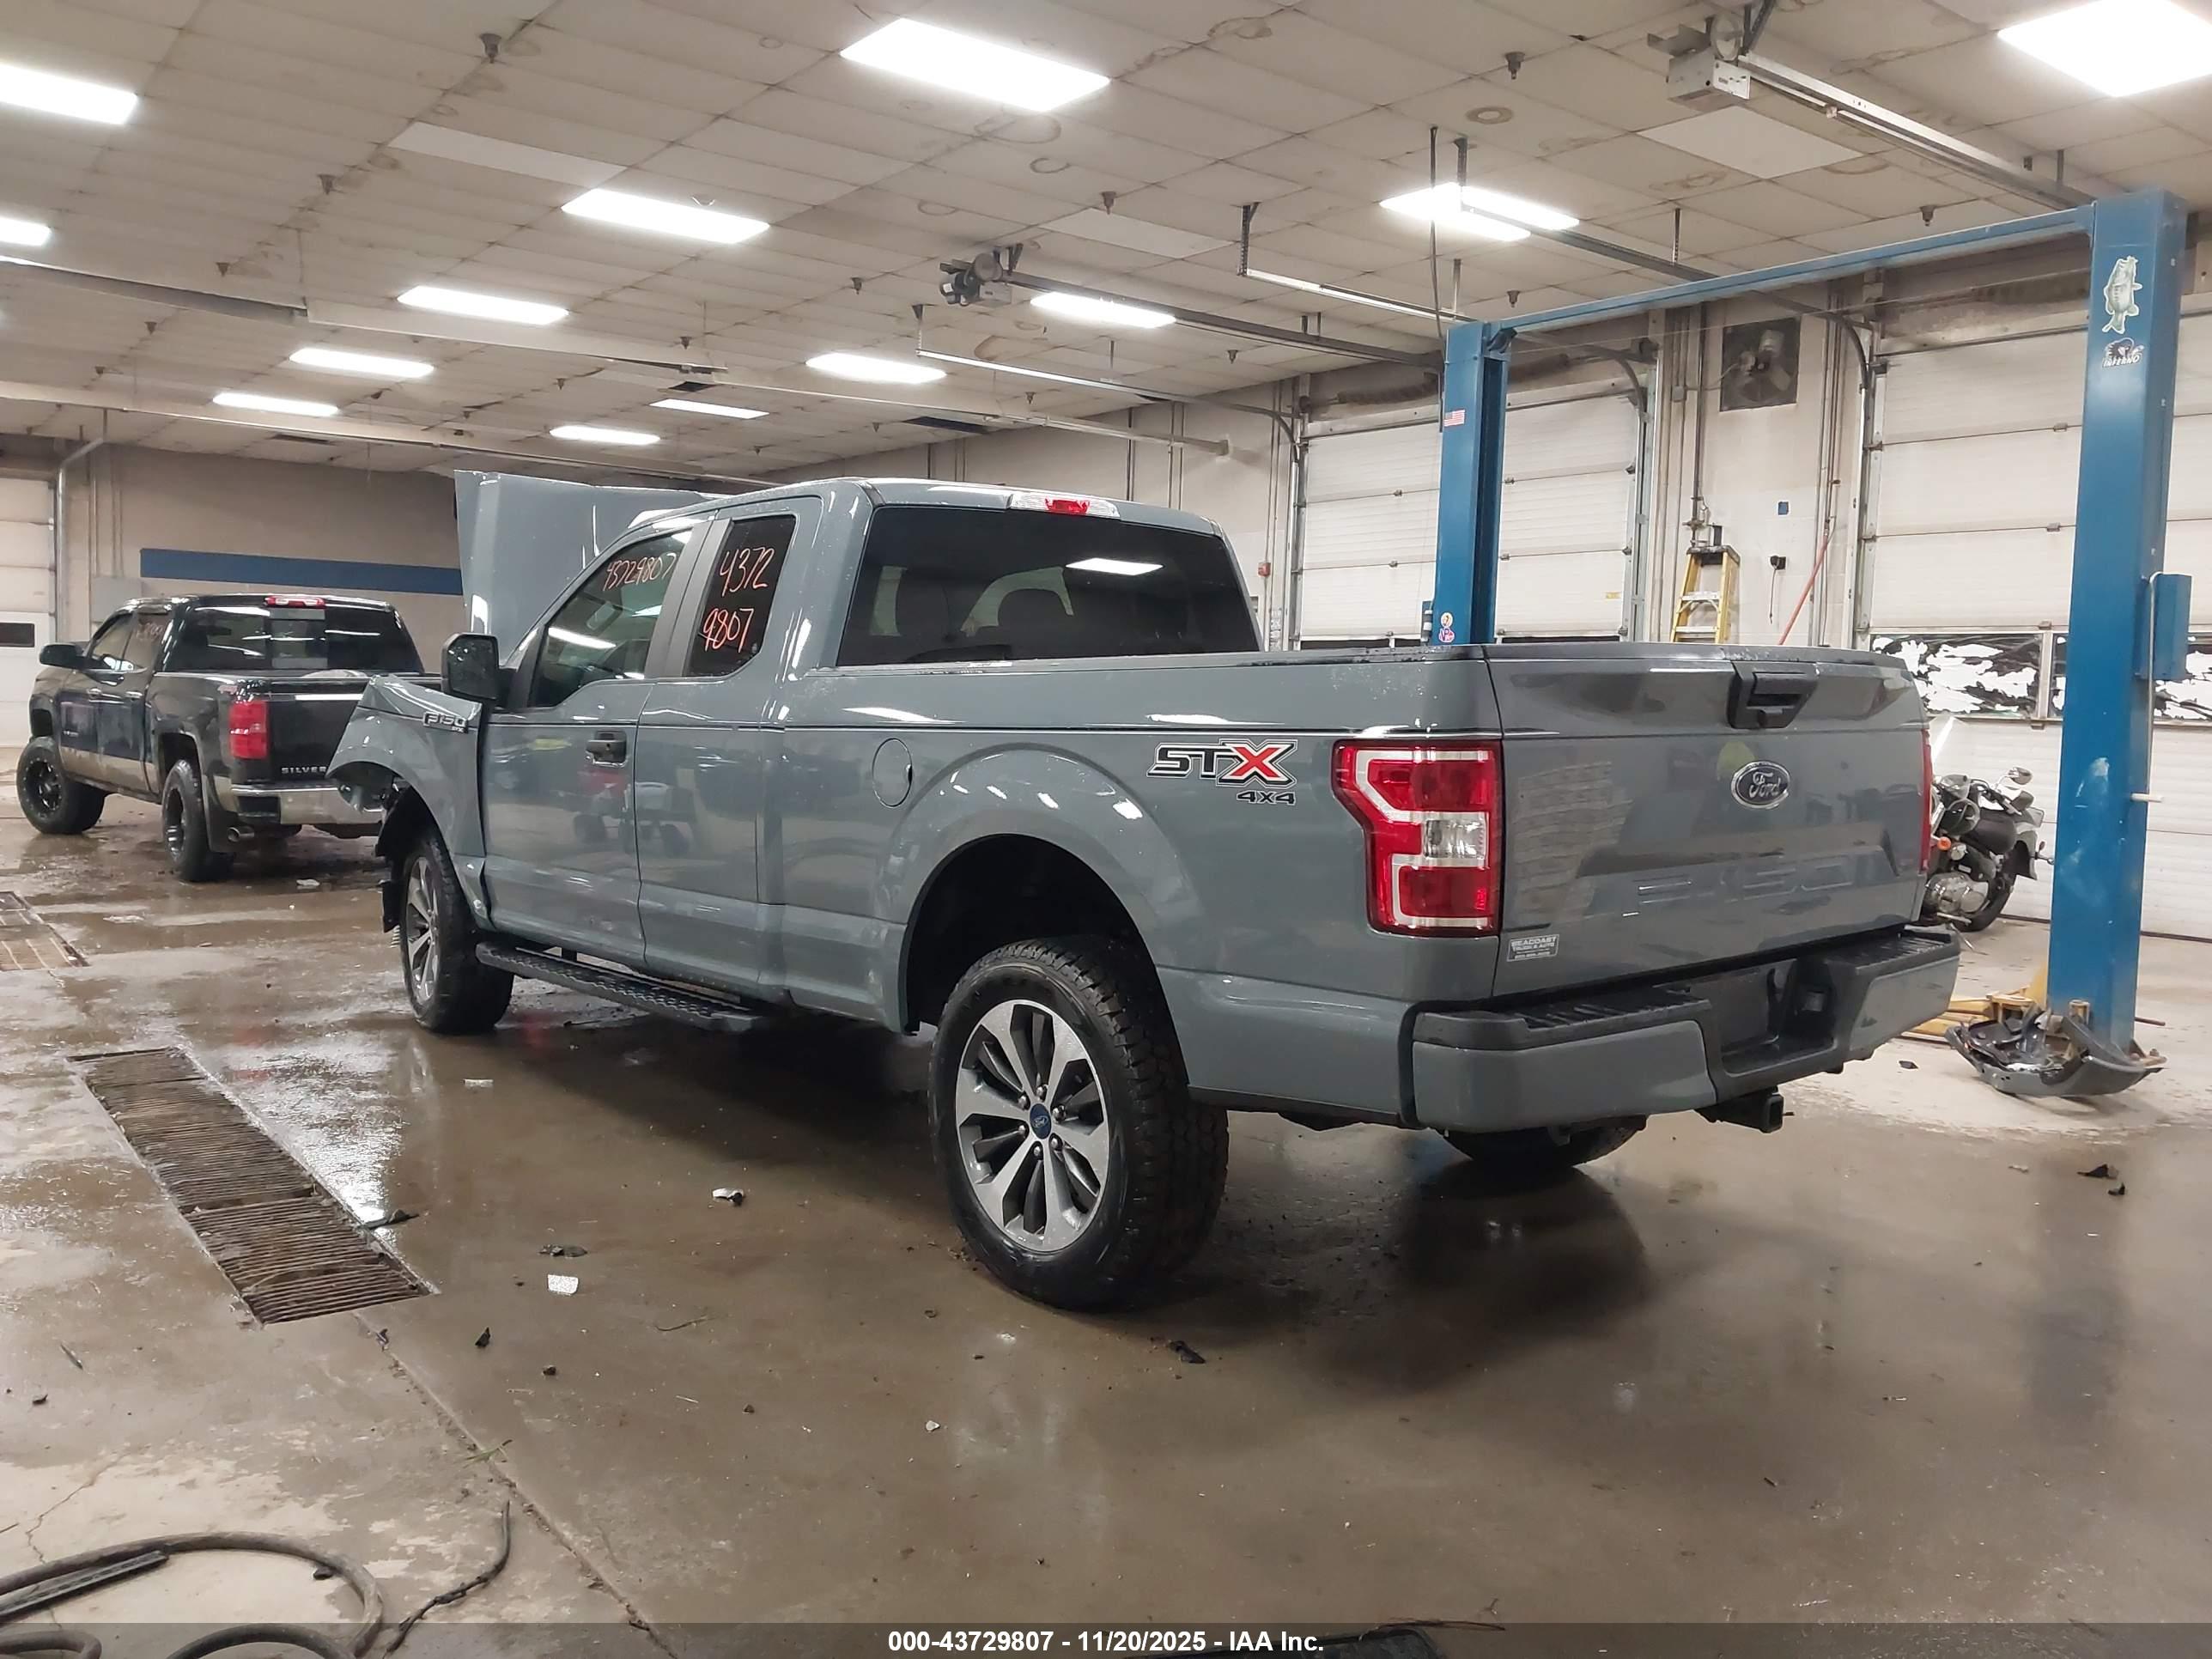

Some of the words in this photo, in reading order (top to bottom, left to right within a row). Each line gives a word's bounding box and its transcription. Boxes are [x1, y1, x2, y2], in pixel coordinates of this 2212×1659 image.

[603, 552, 678, 592] 43729807
[719, 547, 775, 597] 4372
[702, 607, 755, 653] 9807
[1146, 738, 1297, 789] STX
[1749, 772, 1781, 798] Ford
